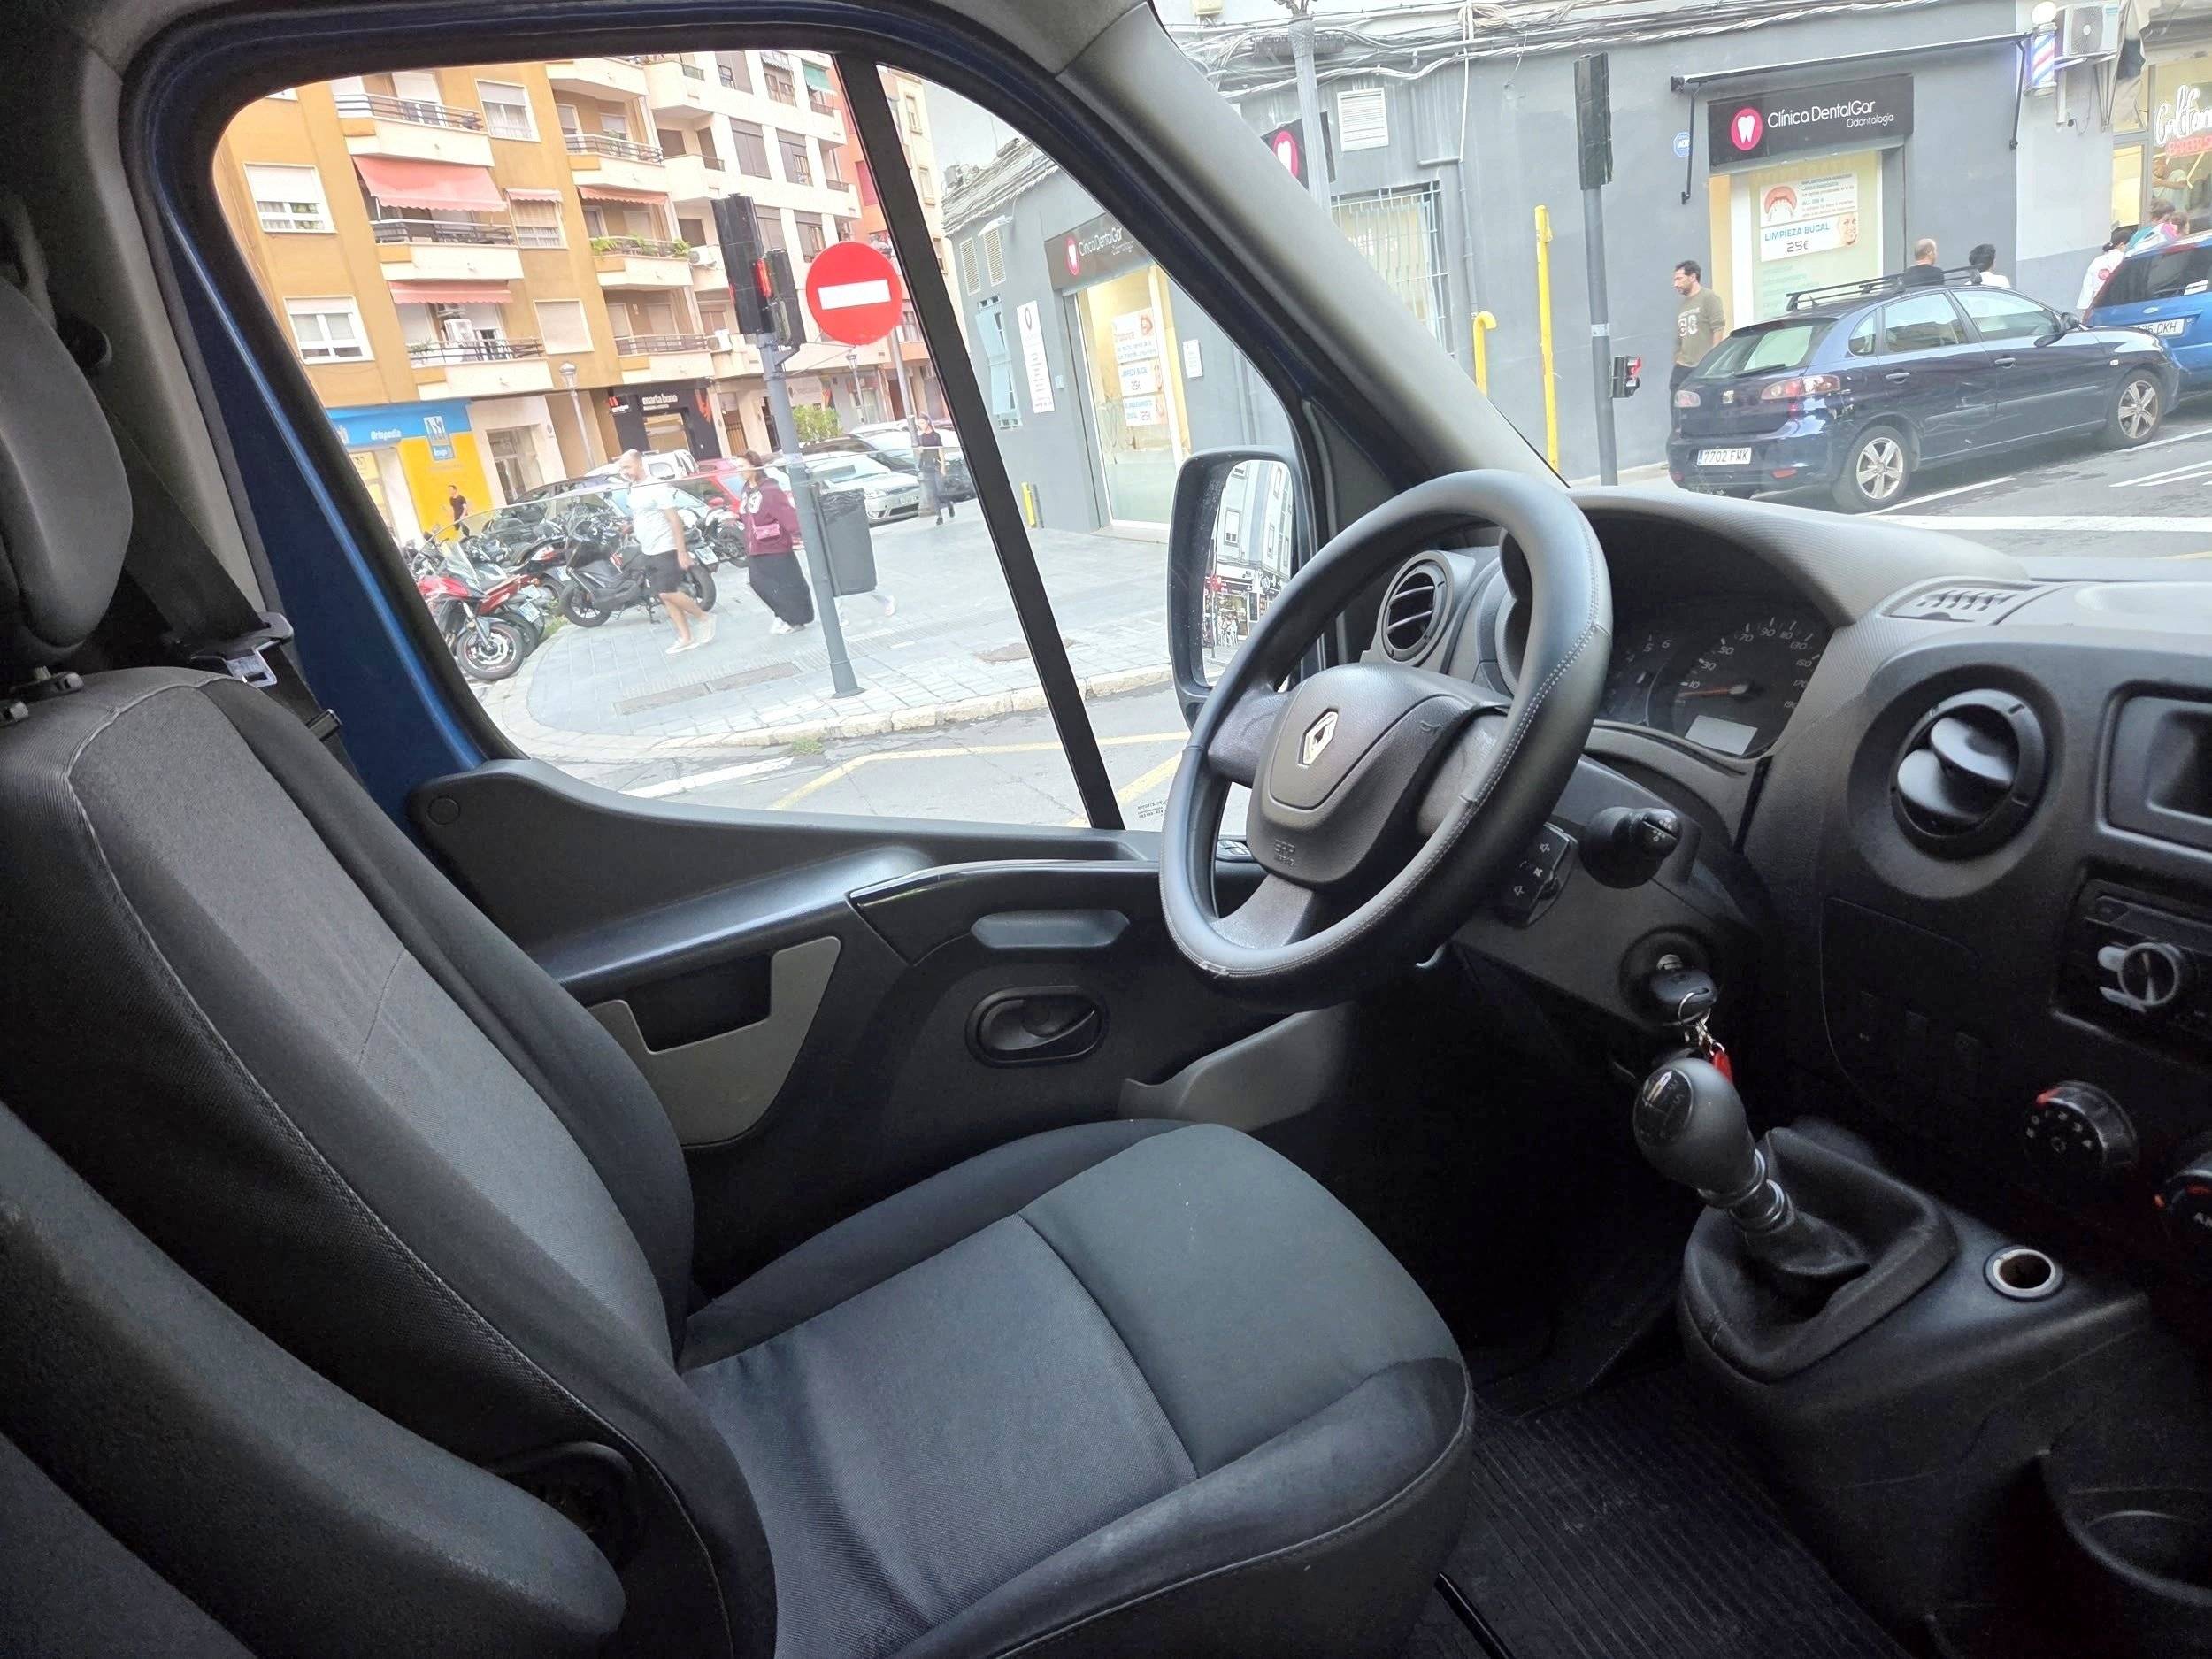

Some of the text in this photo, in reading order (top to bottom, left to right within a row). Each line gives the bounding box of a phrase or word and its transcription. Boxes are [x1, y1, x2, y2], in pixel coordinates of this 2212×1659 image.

[1767, 100, 1876, 128] Clínica DentalGar
[1764, 222, 1831, 242] LIMPIEZA BUCAL
[1786, 240, 1809, 253] 25€
[1704, 450, 1728, 464] 7702
[1759, 627, 1776, 637] 90
[1739, 634, 1754, 642] 70
[1701, 661, 1717, 671] 30
[1689, 680, 1700, 689] 10
